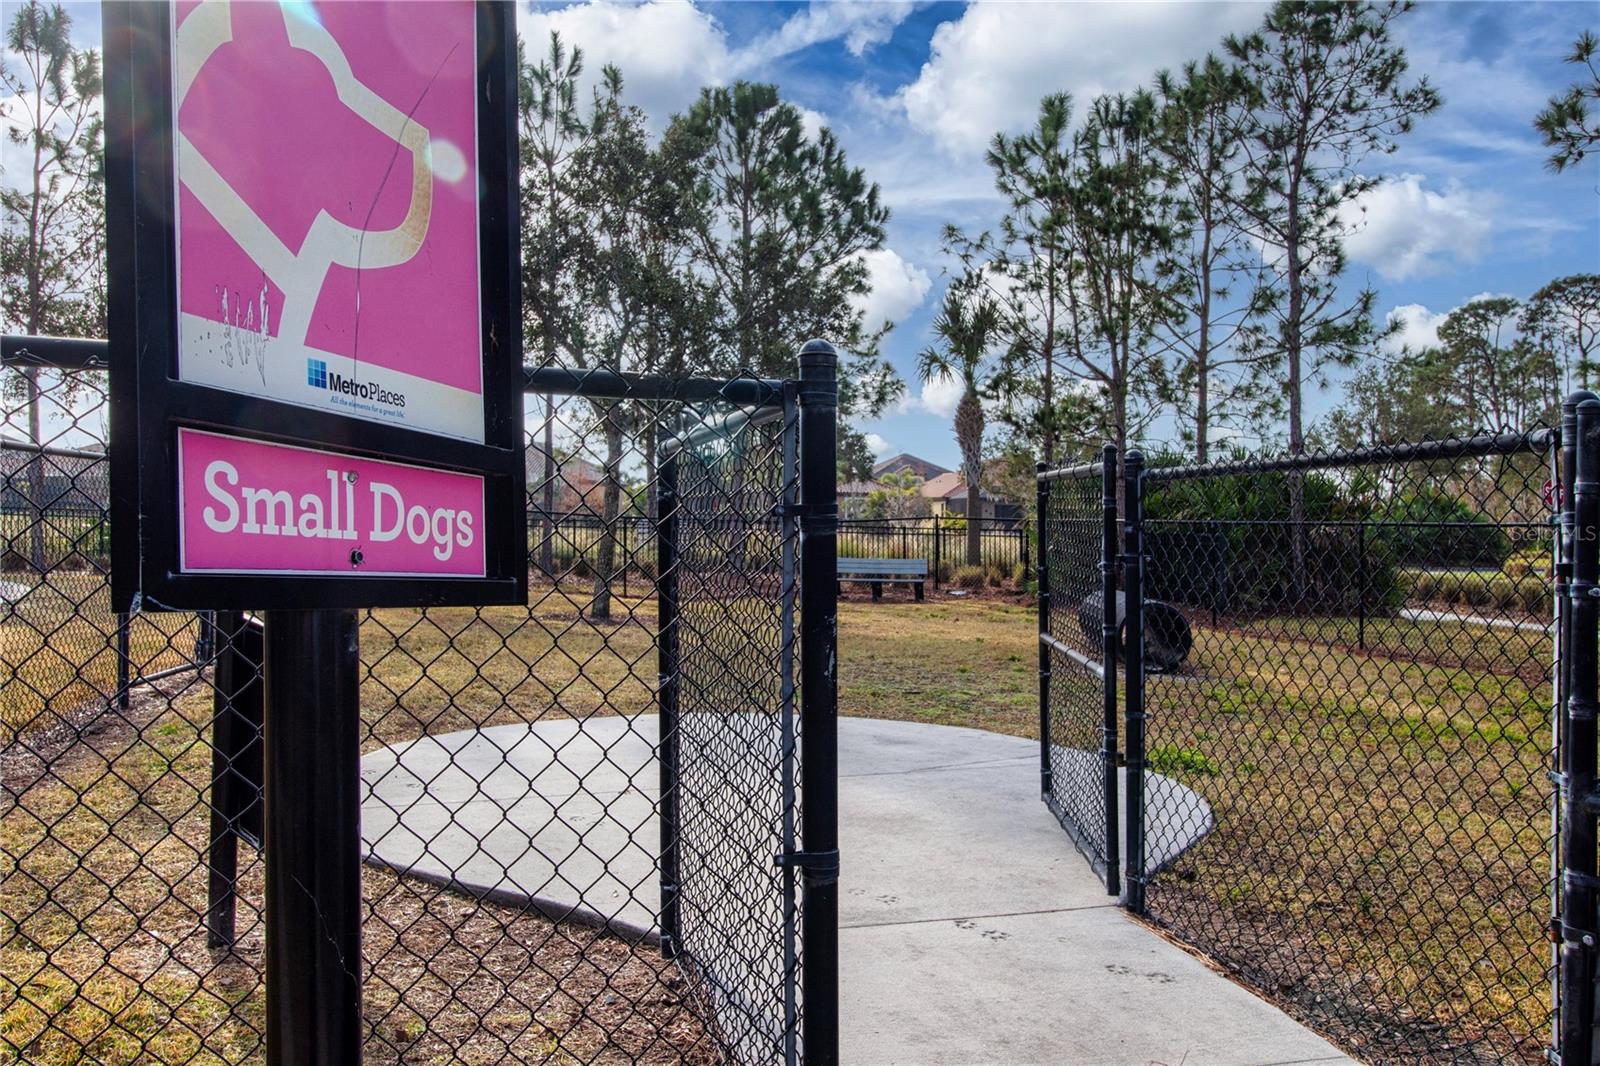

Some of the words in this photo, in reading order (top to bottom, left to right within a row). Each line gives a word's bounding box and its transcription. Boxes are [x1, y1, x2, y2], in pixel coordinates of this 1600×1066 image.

[329, 372, 406, 407] MetroPlaces
[330, 396, 338, 404] All
[339, 397, 348, 406] the
[349, 400, 371, 411] elements
[1544, 486, 1564, 499] SP
[203, 460, 358, 540] Small
[369, 481, 474, 561] Dogs
